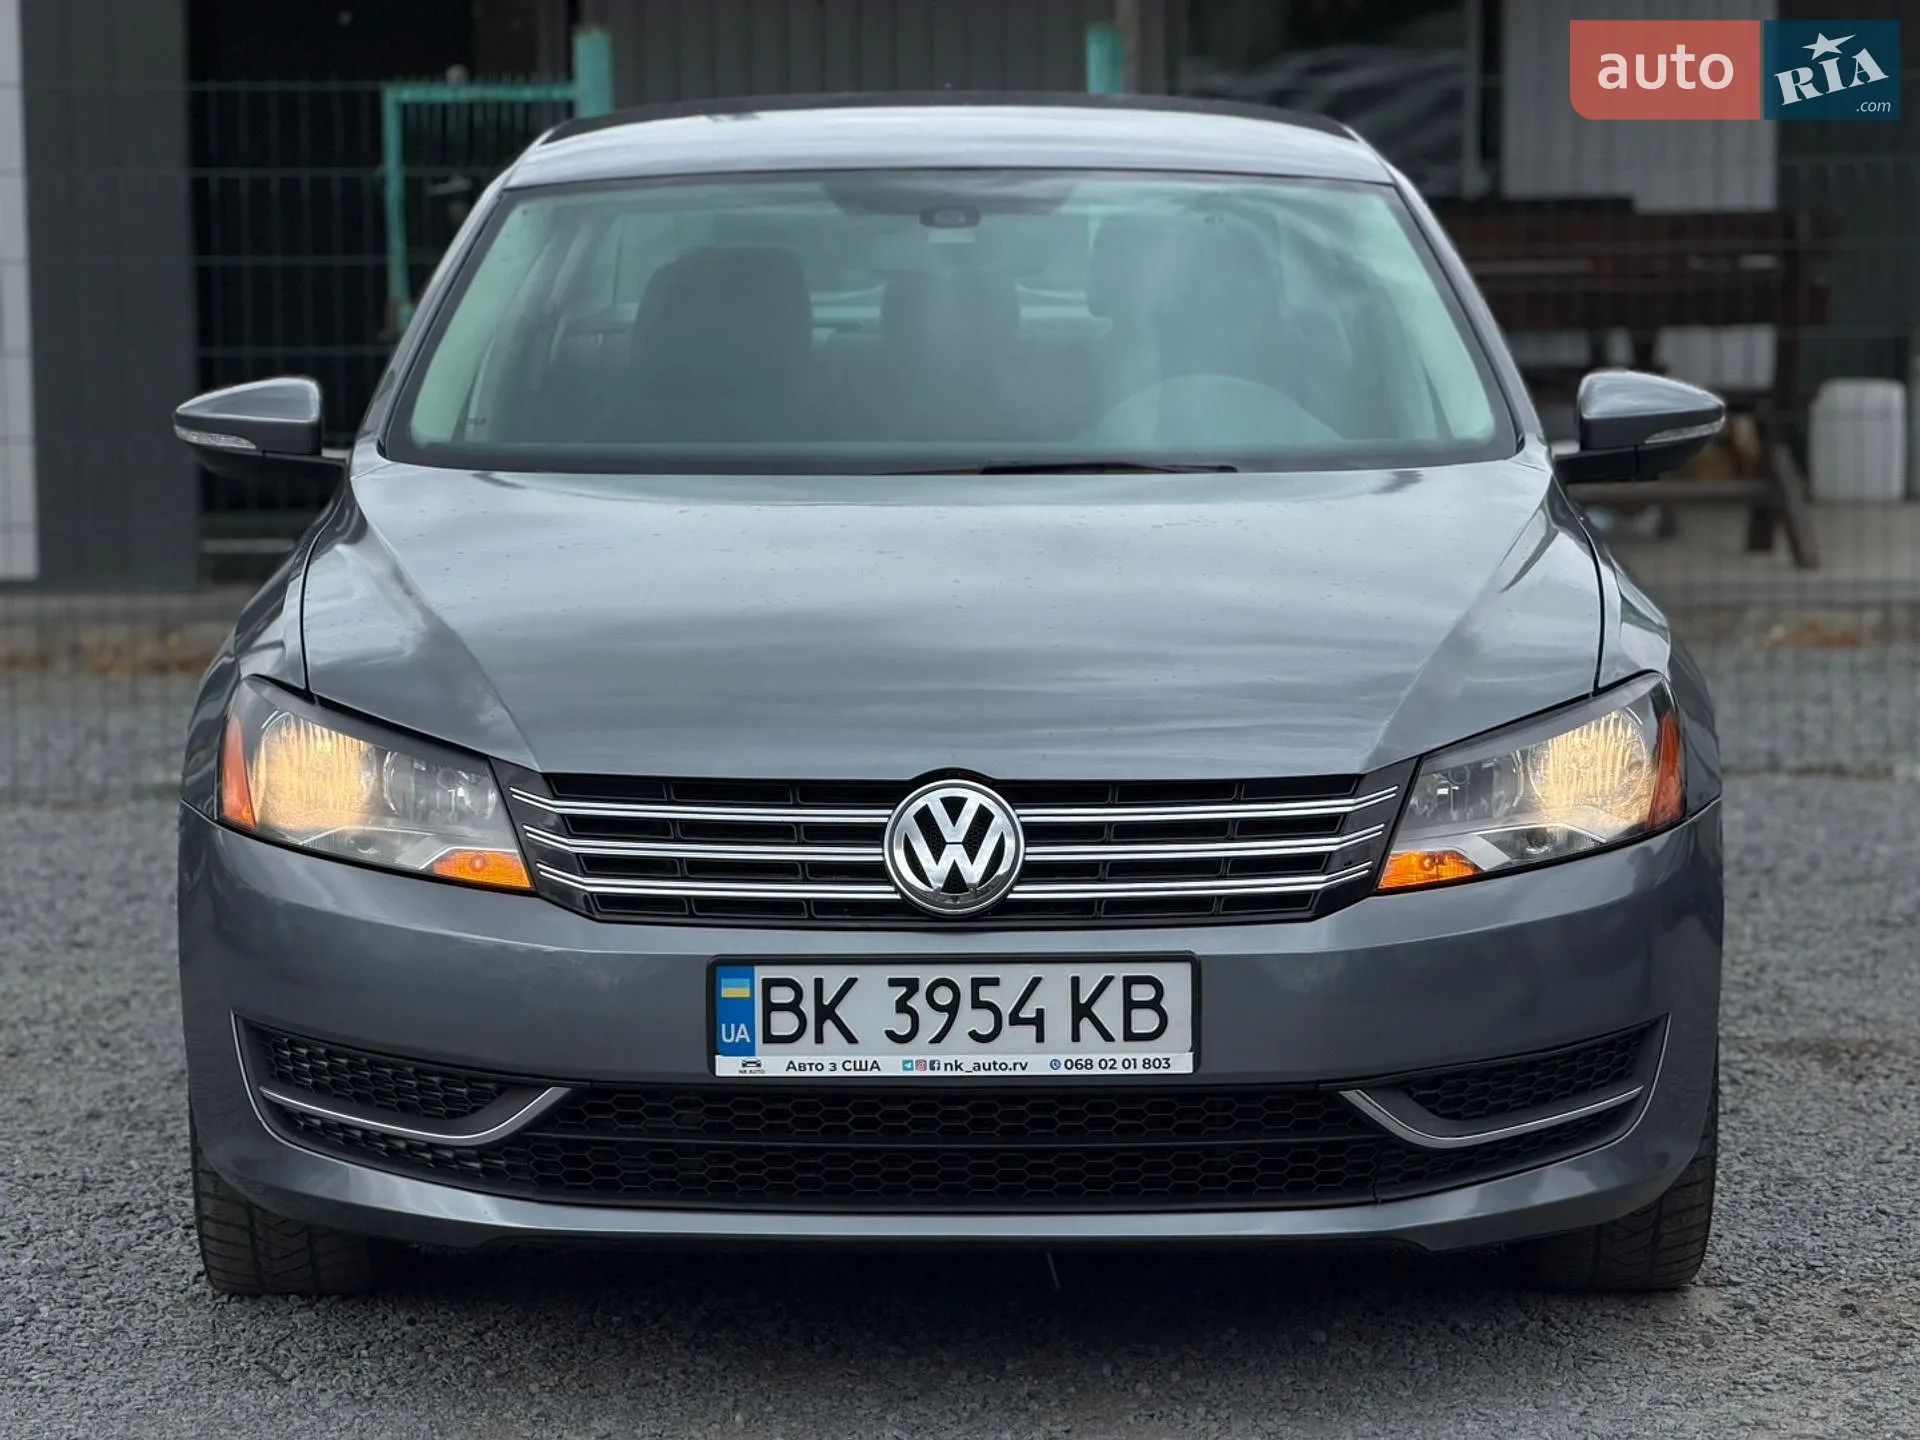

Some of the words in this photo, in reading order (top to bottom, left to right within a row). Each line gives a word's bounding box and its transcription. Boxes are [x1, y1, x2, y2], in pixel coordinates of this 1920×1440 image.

[761, 976, 860, 1045] BK
[884, 976, 1046, 1044] 3954
[1070, 974, 1169, 1043] KB
[721, 1023, 751, 1043] UA
[785, 1059, 825, 1073] Авто
[841, 1058, 882, 1073] США
[943, 1059, 1029, 1073] nk_auto.rv
[1064, 1058, 1094, 1071] 068
[1098, 1058, 1118, 1071] 02
[1121, 1057, 1138, 1070] 01
[1142, 1057, 1171, 1070] 803
